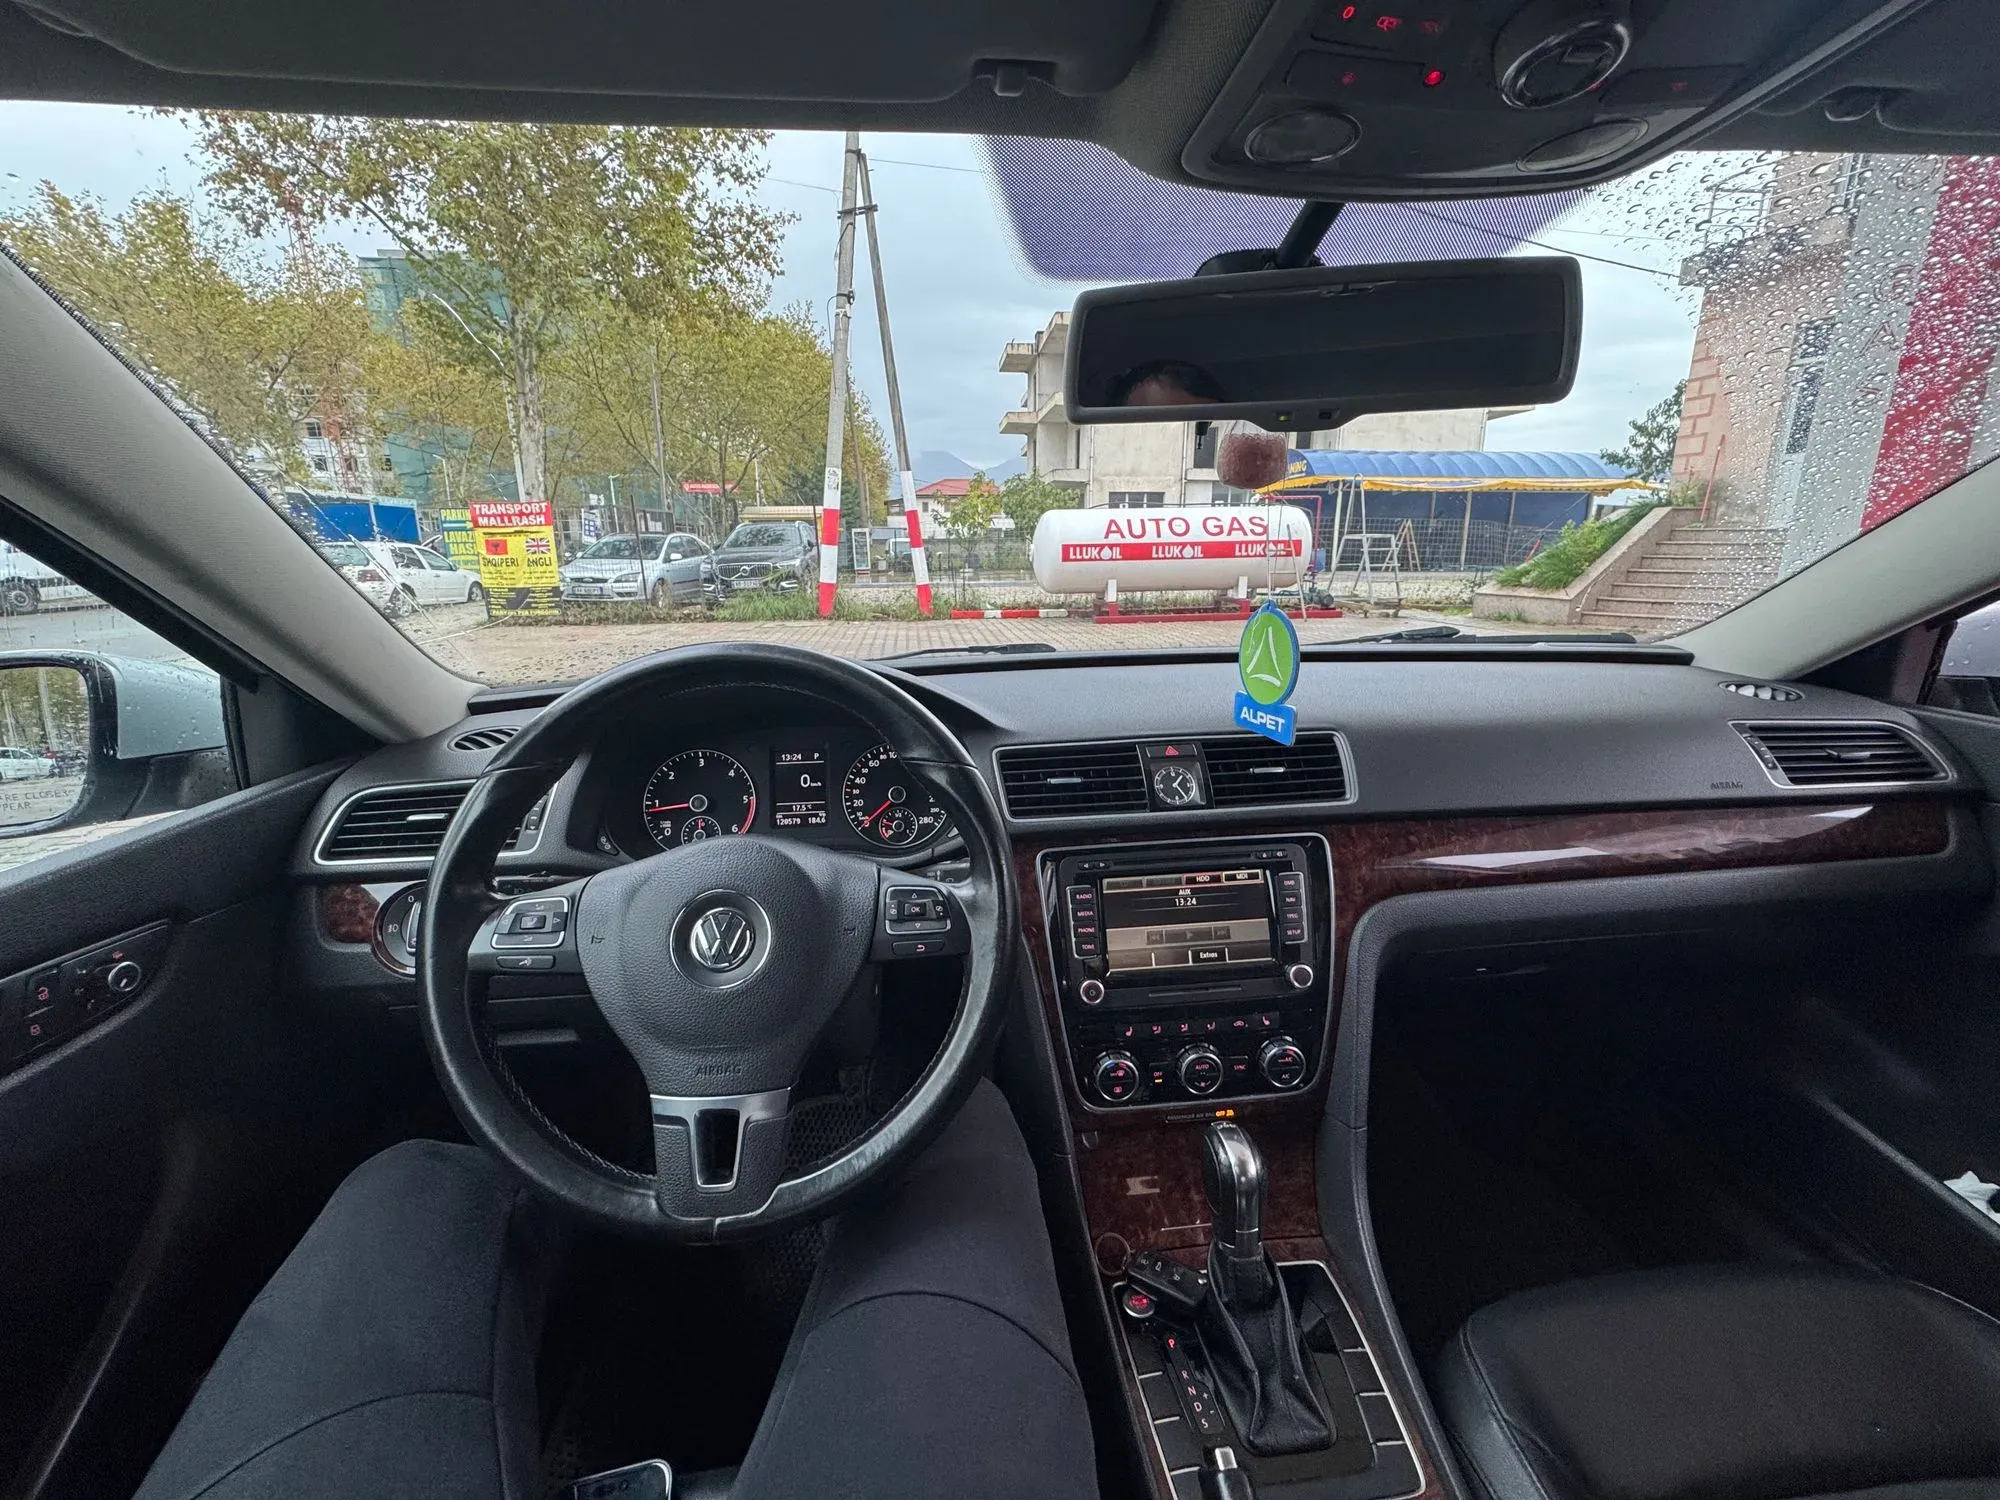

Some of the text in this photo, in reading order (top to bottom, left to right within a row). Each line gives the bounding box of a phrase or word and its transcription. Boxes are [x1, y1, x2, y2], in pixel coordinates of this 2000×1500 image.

[473, 502, 548, 515] TRANSPORT
[478, 513, 546, 527] MALLRASH
[1104, 516, 1267, 539] AUTO GAS
[1070, 545, 1123, 560] LLUKOIL
[1152, 543, 1203, 559] LLUKOIL
[482, 556, 519, 568] SHQIPERI
[527, 556, 553, 568] ANGLI
[1240, 706, 1285, 732] ALPET
[781, 753, 802, 761] 13:24
[699, 759, 705, 767] 3
[668, 772, 675, 780] 2
[728, 769, 735, 777] 4
[800, 774, 810, 787] 0
[743, 795, 749, 803] 5
[853, 799, 864, 807] 20
[919, 816, 933, 824] 280
[664, 828, 671, 836] 0
[731, 824, 738, 832] 6
[1175, 897, 1197, 906] 13:24
[1168, 1338, 1175, 1349] P
[1181, 1370, 1189, 1380] R
[1187, 1385, 1197, 1396] N
[1194, 1402, 1202, 1412] D
[1201, 1418, 1209, 1428] S
